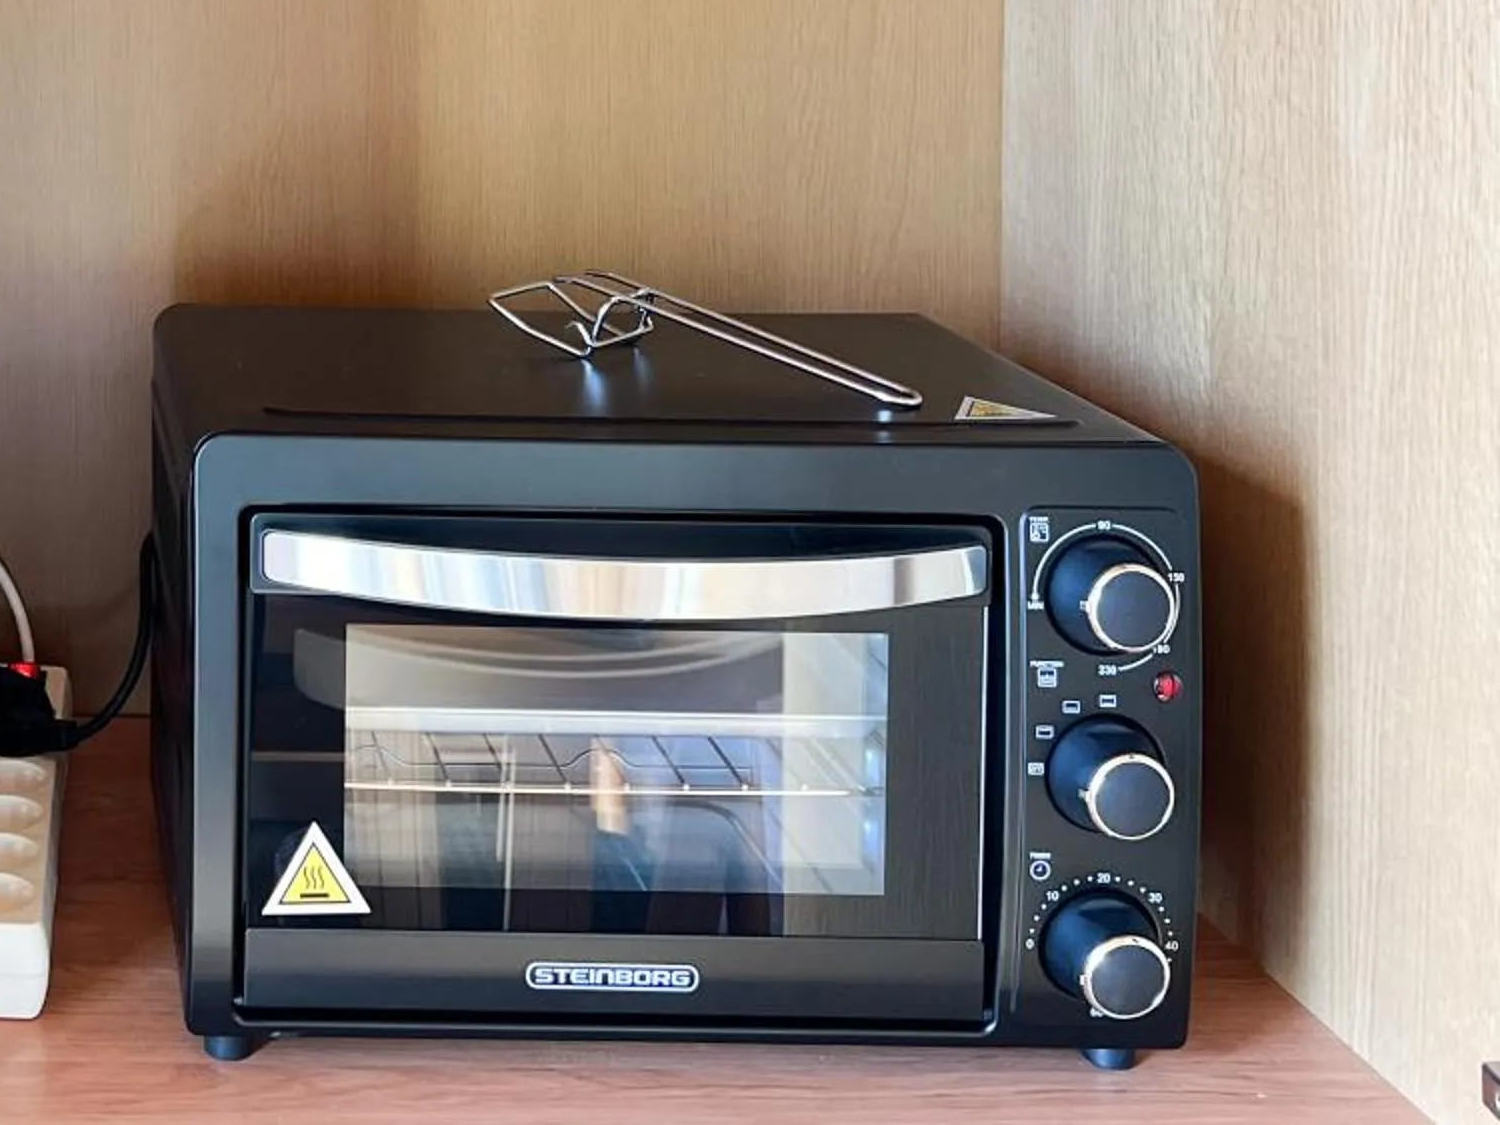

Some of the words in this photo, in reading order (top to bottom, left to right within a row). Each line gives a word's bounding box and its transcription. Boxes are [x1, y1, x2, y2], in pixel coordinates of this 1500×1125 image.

[1097, 873, 1111, 884] 20
[1046, 891, 1059, 901] 10
[1148, 892, 1163, 903] 30
[1025, 938, 1035, 949] 0
[1165, 941, 1179, 951] 40
[534, 967, 691, 986] STEINBORG
